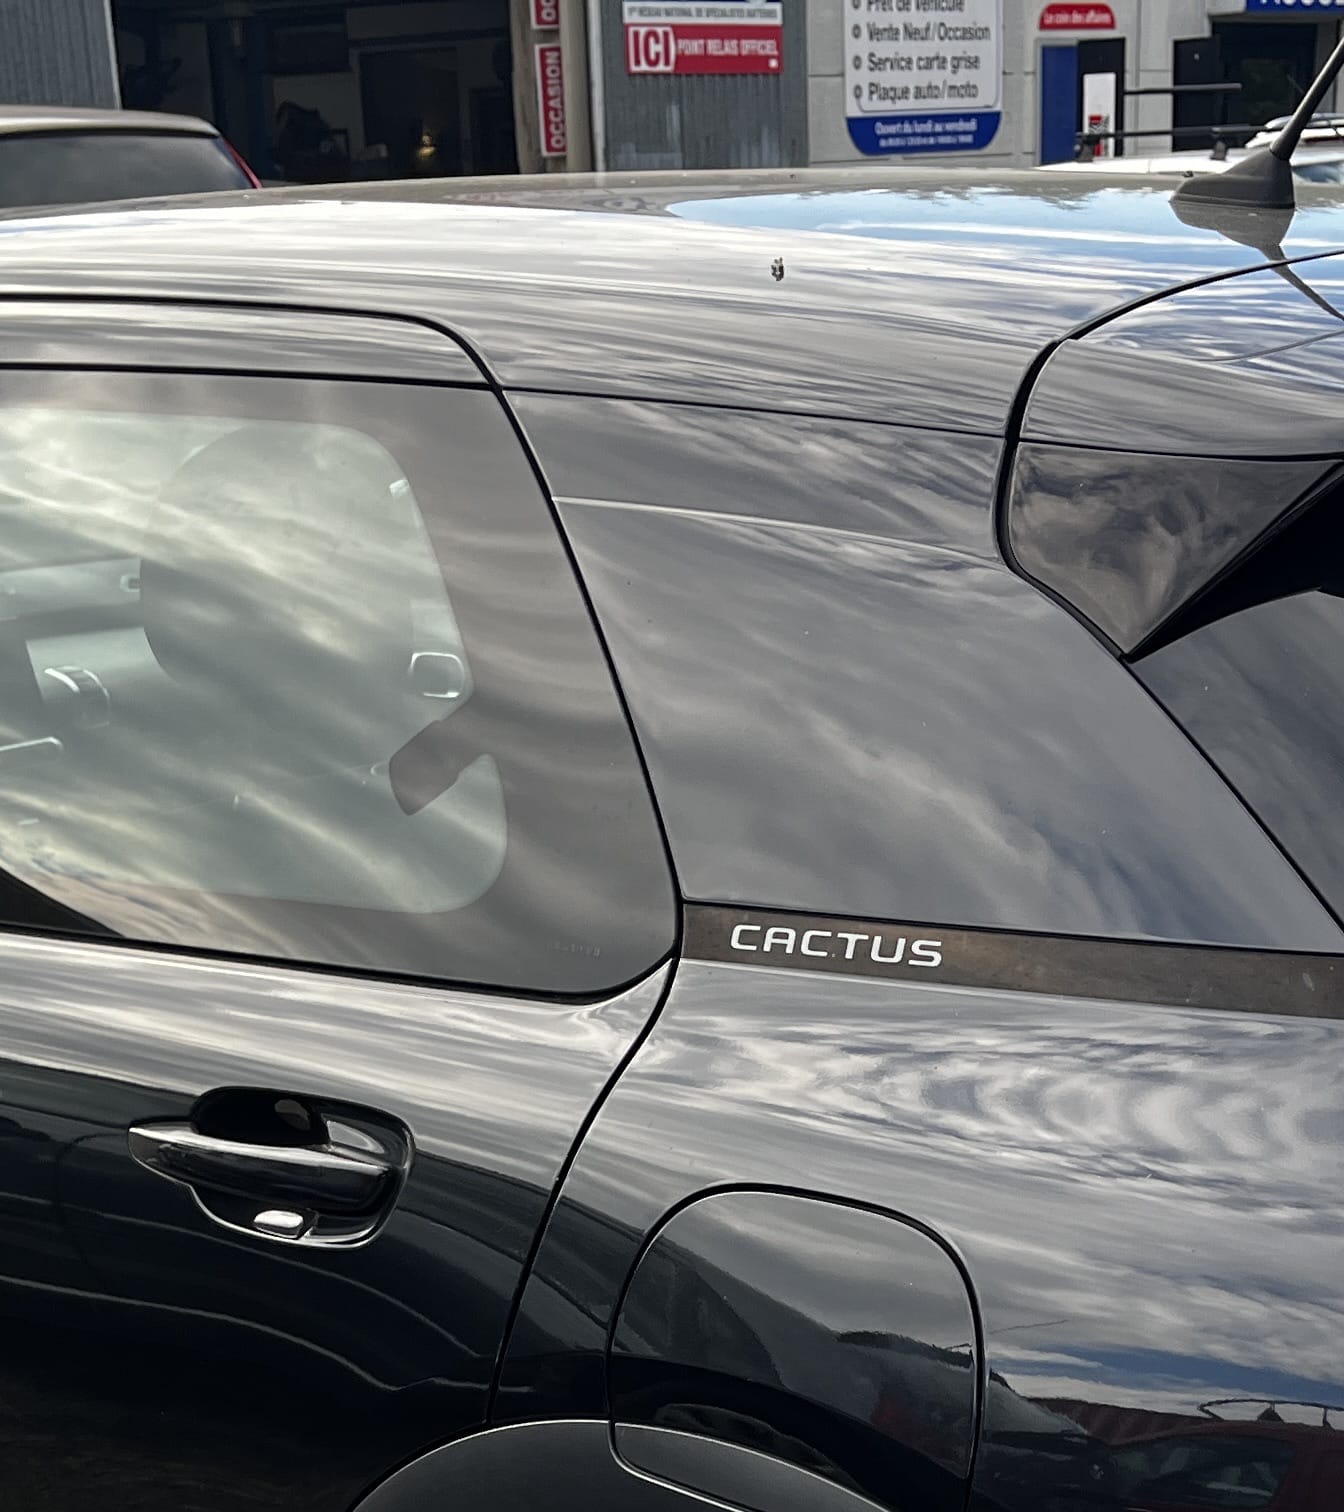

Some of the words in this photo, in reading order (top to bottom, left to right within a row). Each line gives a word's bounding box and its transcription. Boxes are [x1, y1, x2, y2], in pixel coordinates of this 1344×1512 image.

[866, 22, 900, 41] Vente
[632, 29, 671, 67] ICI
[677, 39, 705, 55] POINT
[867, 51, 913, 72] Service
[916, 52, 948, 70] carte
[950, 51, 981, 74] grise
[545, 50, 564, 149] OCCASION
[867, 81, 911, 104] Plaque
[730, 924, 942, 968] CACTUS
